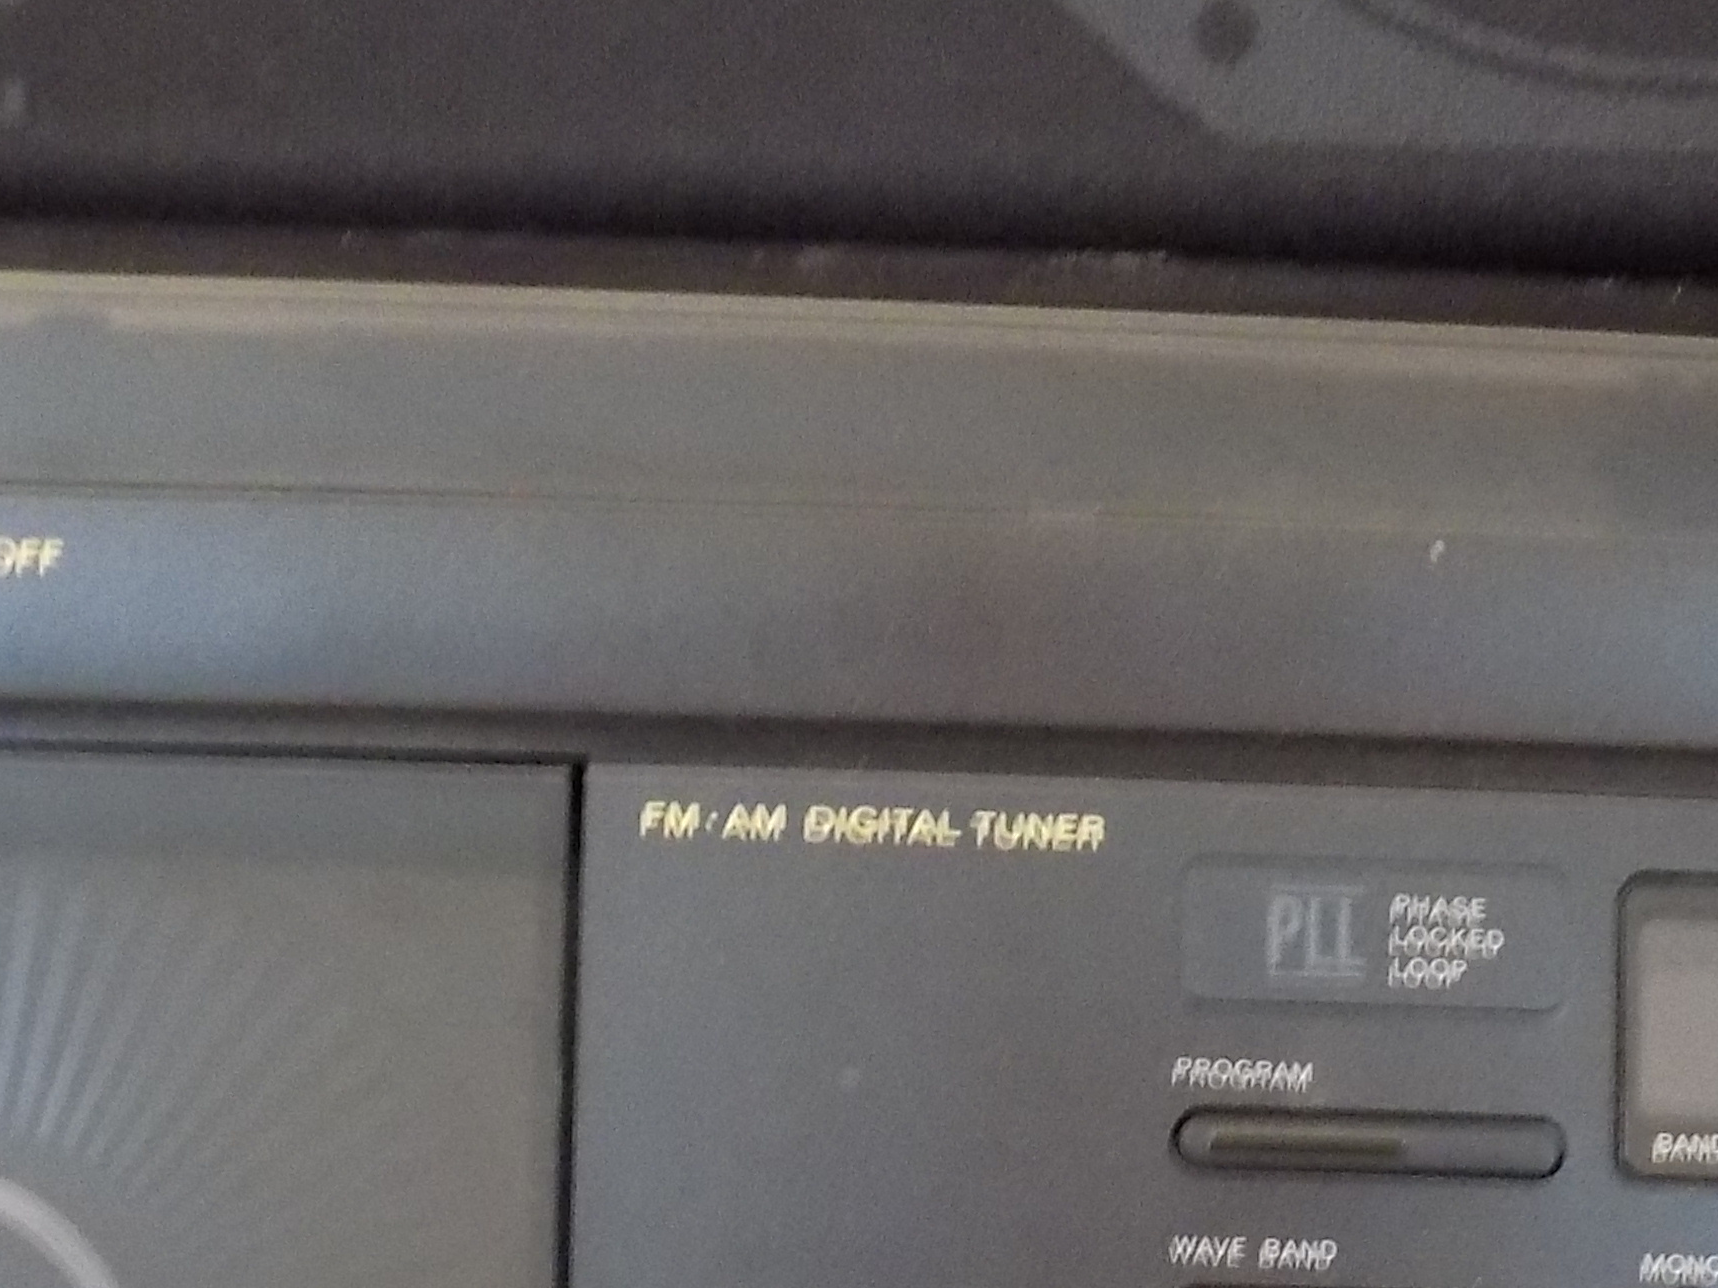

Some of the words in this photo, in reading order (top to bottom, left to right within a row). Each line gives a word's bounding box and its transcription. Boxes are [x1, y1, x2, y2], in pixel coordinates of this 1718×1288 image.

[803, 804, 962, 848] DIGITAL
[971, 810, 1106, 852] TUNER
[1389, 892, 1487, 926] PHASE
[1388, 925, 1505, 960] LOCKED
[1388, 957, 1468, 989] LOOP
[1172, 1055, 1314, 1092] PROGRAM
[1169, 1235, 1246, 1268] WAVE
[1259, 1239, 1338, 1272] BAND
